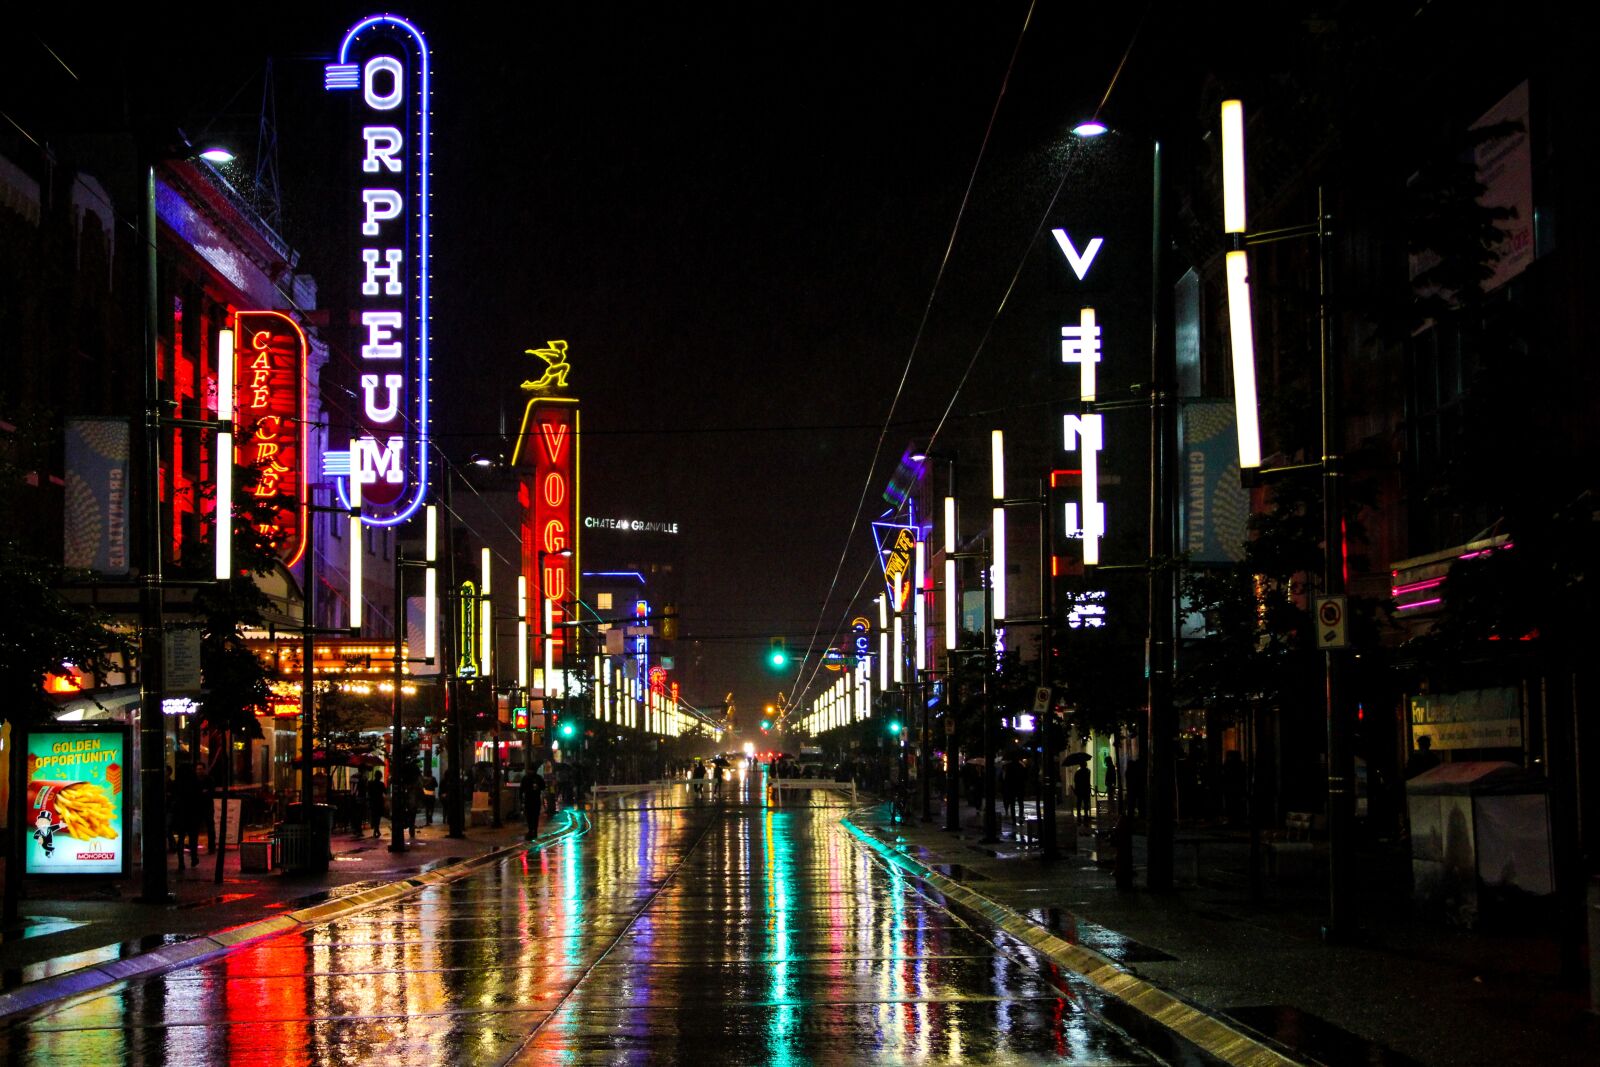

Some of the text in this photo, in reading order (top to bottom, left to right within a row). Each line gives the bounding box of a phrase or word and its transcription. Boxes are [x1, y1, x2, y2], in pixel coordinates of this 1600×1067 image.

[361, 56, 404, 485] ORPHEUM
[250, 331, 290, 549] CAFÉ CRÊ
[1188, 451, 1205, 553] GRANVILLE
[631, 520, 678, 533] GRANVILLE
[1411, 701, 1425, 723] For
[53, 739, 101, 754] GOLDEN
[35, 750, 118, 769] OPPORTUNITY
